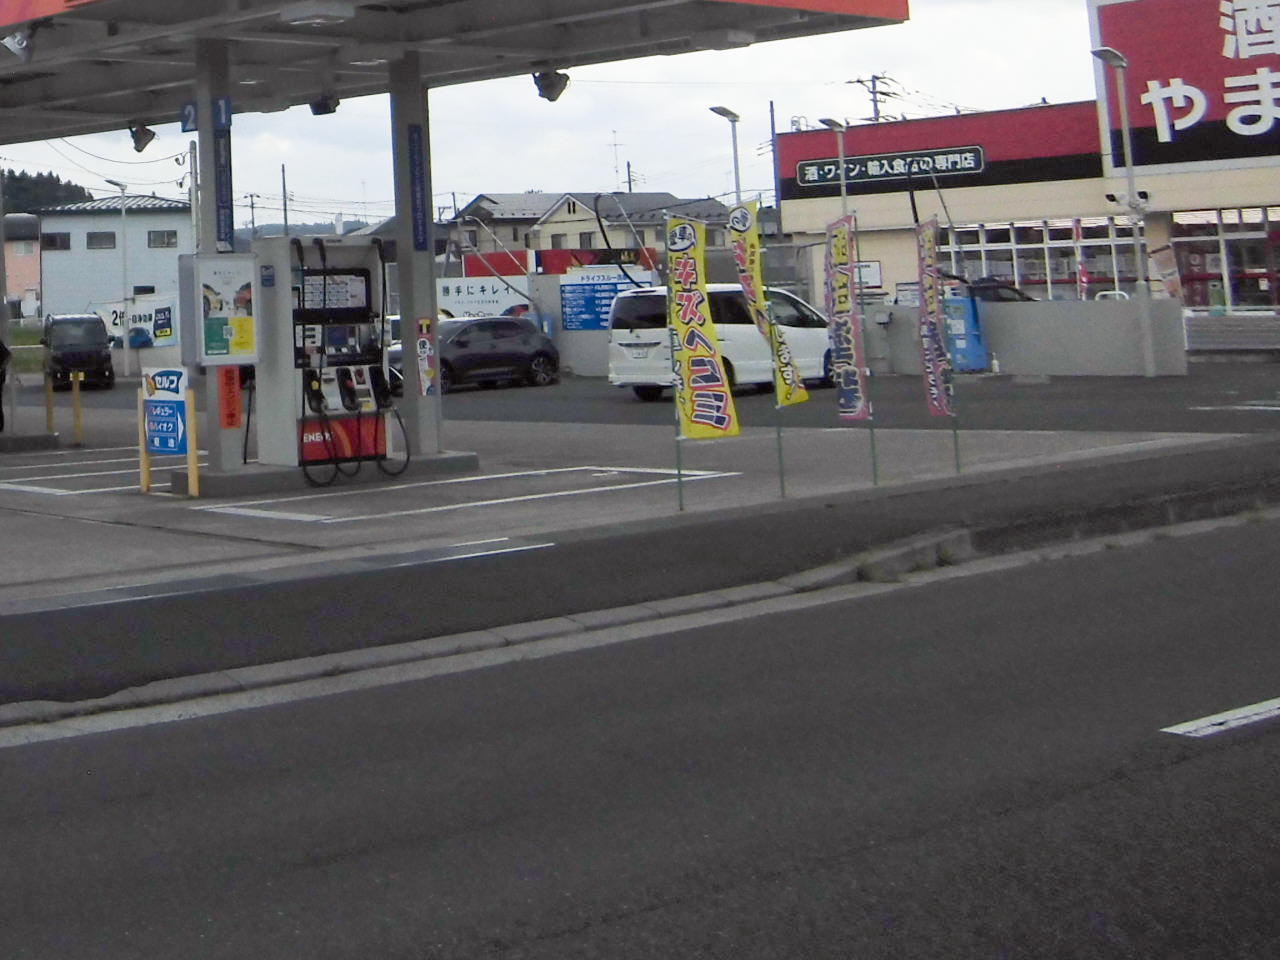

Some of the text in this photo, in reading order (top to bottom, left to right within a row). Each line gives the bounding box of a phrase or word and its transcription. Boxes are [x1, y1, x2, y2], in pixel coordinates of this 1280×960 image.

[184, 104, 196, 131] 2
[218, 99, 227, 124] 1
[1140, 67, 1280, 143] やま
[154, 375, 178, 390] セルフ
